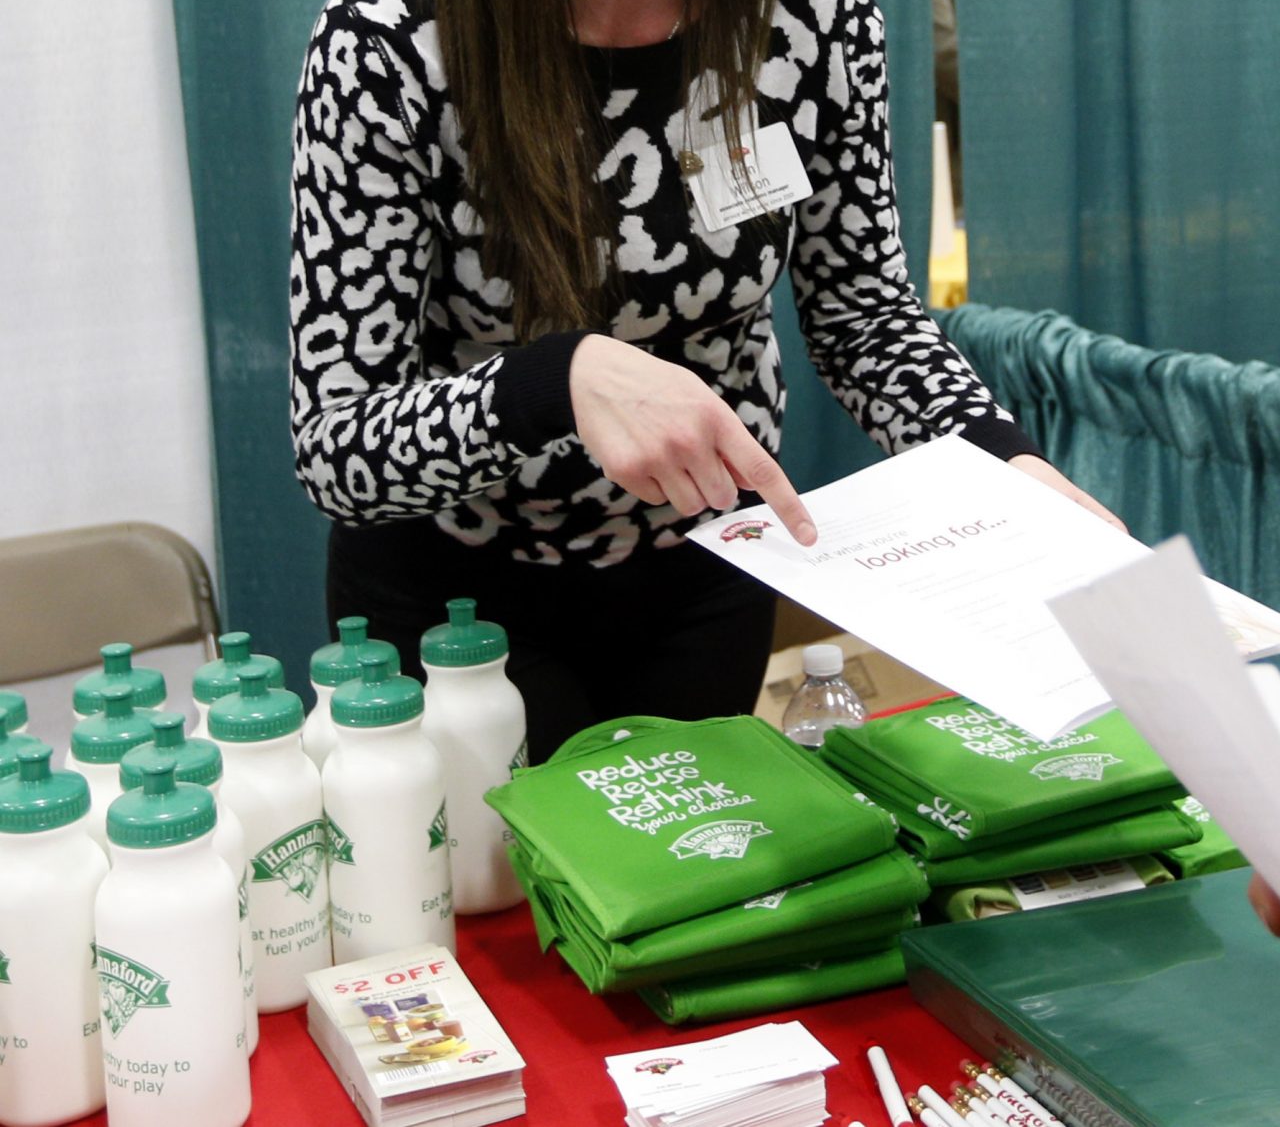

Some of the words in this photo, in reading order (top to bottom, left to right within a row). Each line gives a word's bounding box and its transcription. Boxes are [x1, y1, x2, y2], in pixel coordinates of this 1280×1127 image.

[734, 176, 771, 195] Wilon
[854, 532, 953, 570] looking
[948, 517, 1008, 543] for...
[925, 708, 1001, 730] Redu
[950, 721, 1021, 741] Reu
[576, 750, 697, 790] Reduce
[600, 765, 700, 805] Reuse
[607, 781, 735, 826] Rethink
[632, 810, 686, 835] your
[688, 794, 757, 815] choices
[680, 823, 753, 850] Hannaford
[251, 930, 265, 942] at
[269, 916, 316, 940] healthy
[358, 911, 372, 924] to
[265, 941, 292, 957] fuel
[334, 980, 373, 994] $2
[385, 961, 446, 985] OFF
[13, 1035, 28, 1049] to
[126, 1058, 168, 1077] today
[174, 1059, 191, 1073] to
[133, 1078, 164, 1096] play
